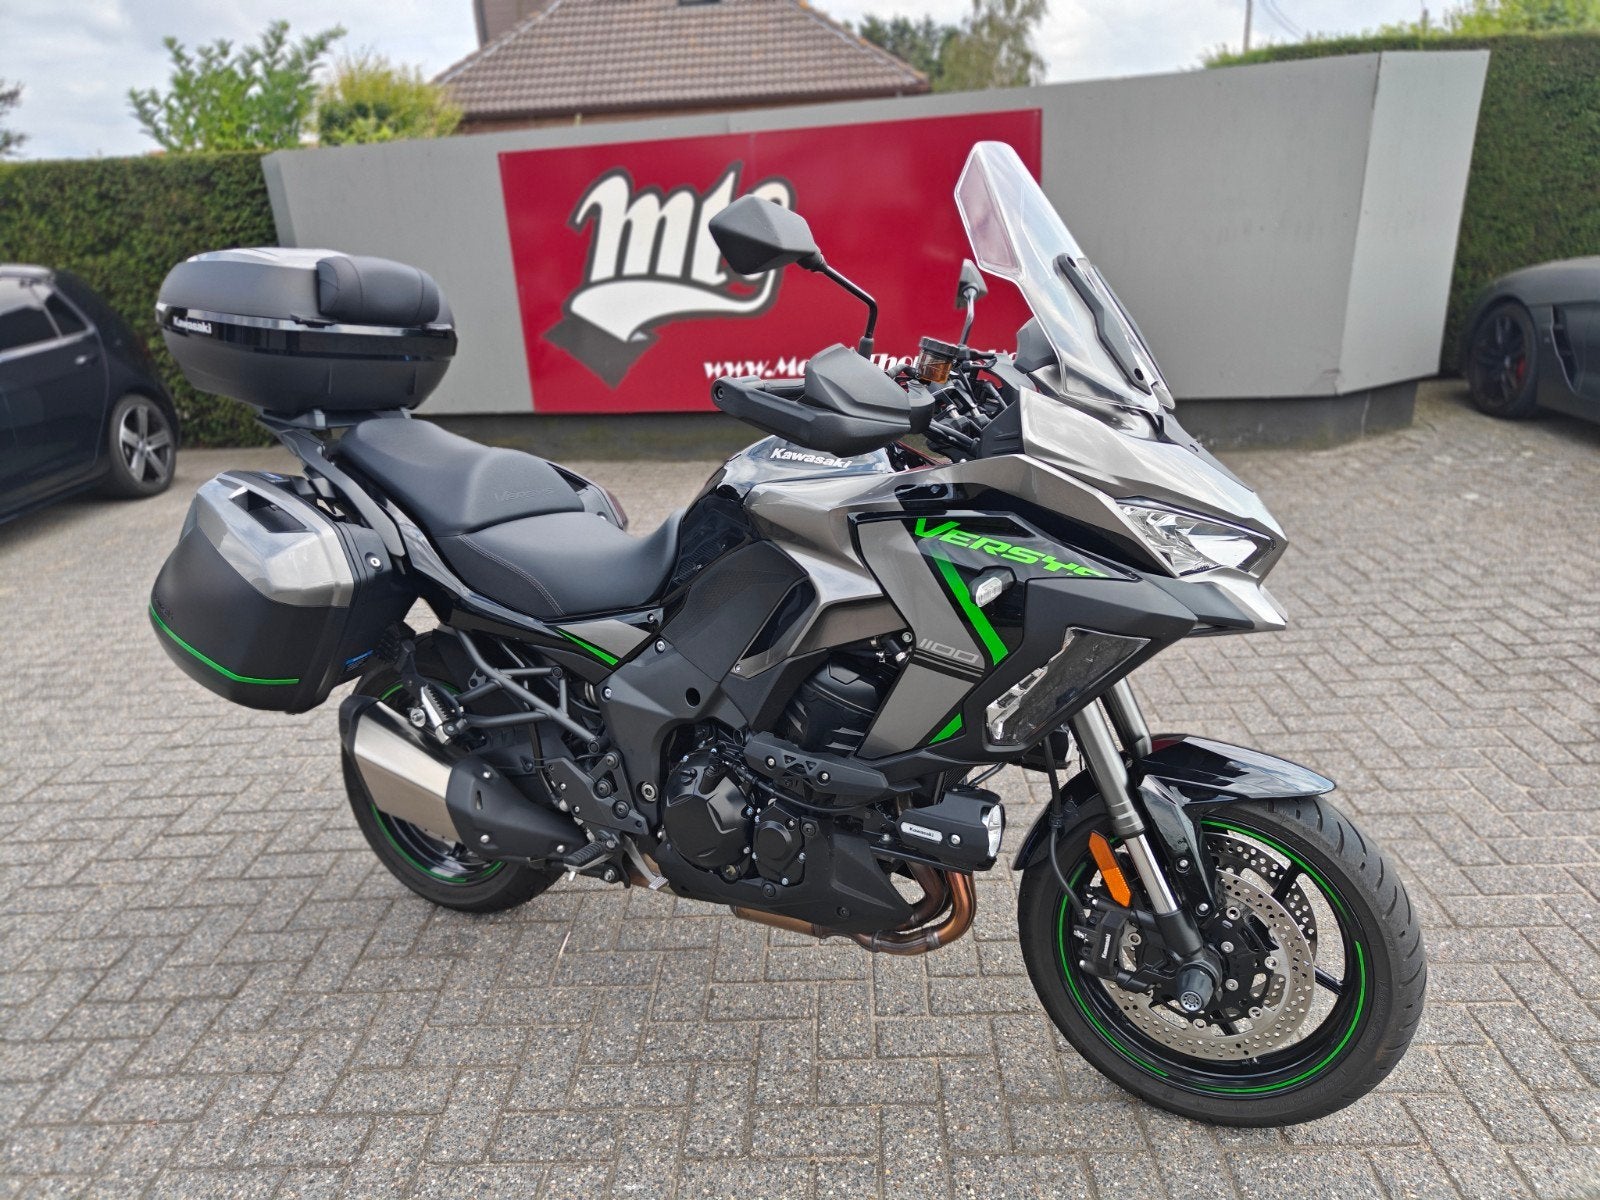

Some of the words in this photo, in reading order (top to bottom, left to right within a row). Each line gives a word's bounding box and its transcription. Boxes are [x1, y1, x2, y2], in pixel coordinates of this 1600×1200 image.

[172, 315, 212, 334] Kawasaki
[770, 447, 853, 469] Kawasaki
[919, 638, 979, 664] 1100
[909, 826, 935, 838] Kawasaki
